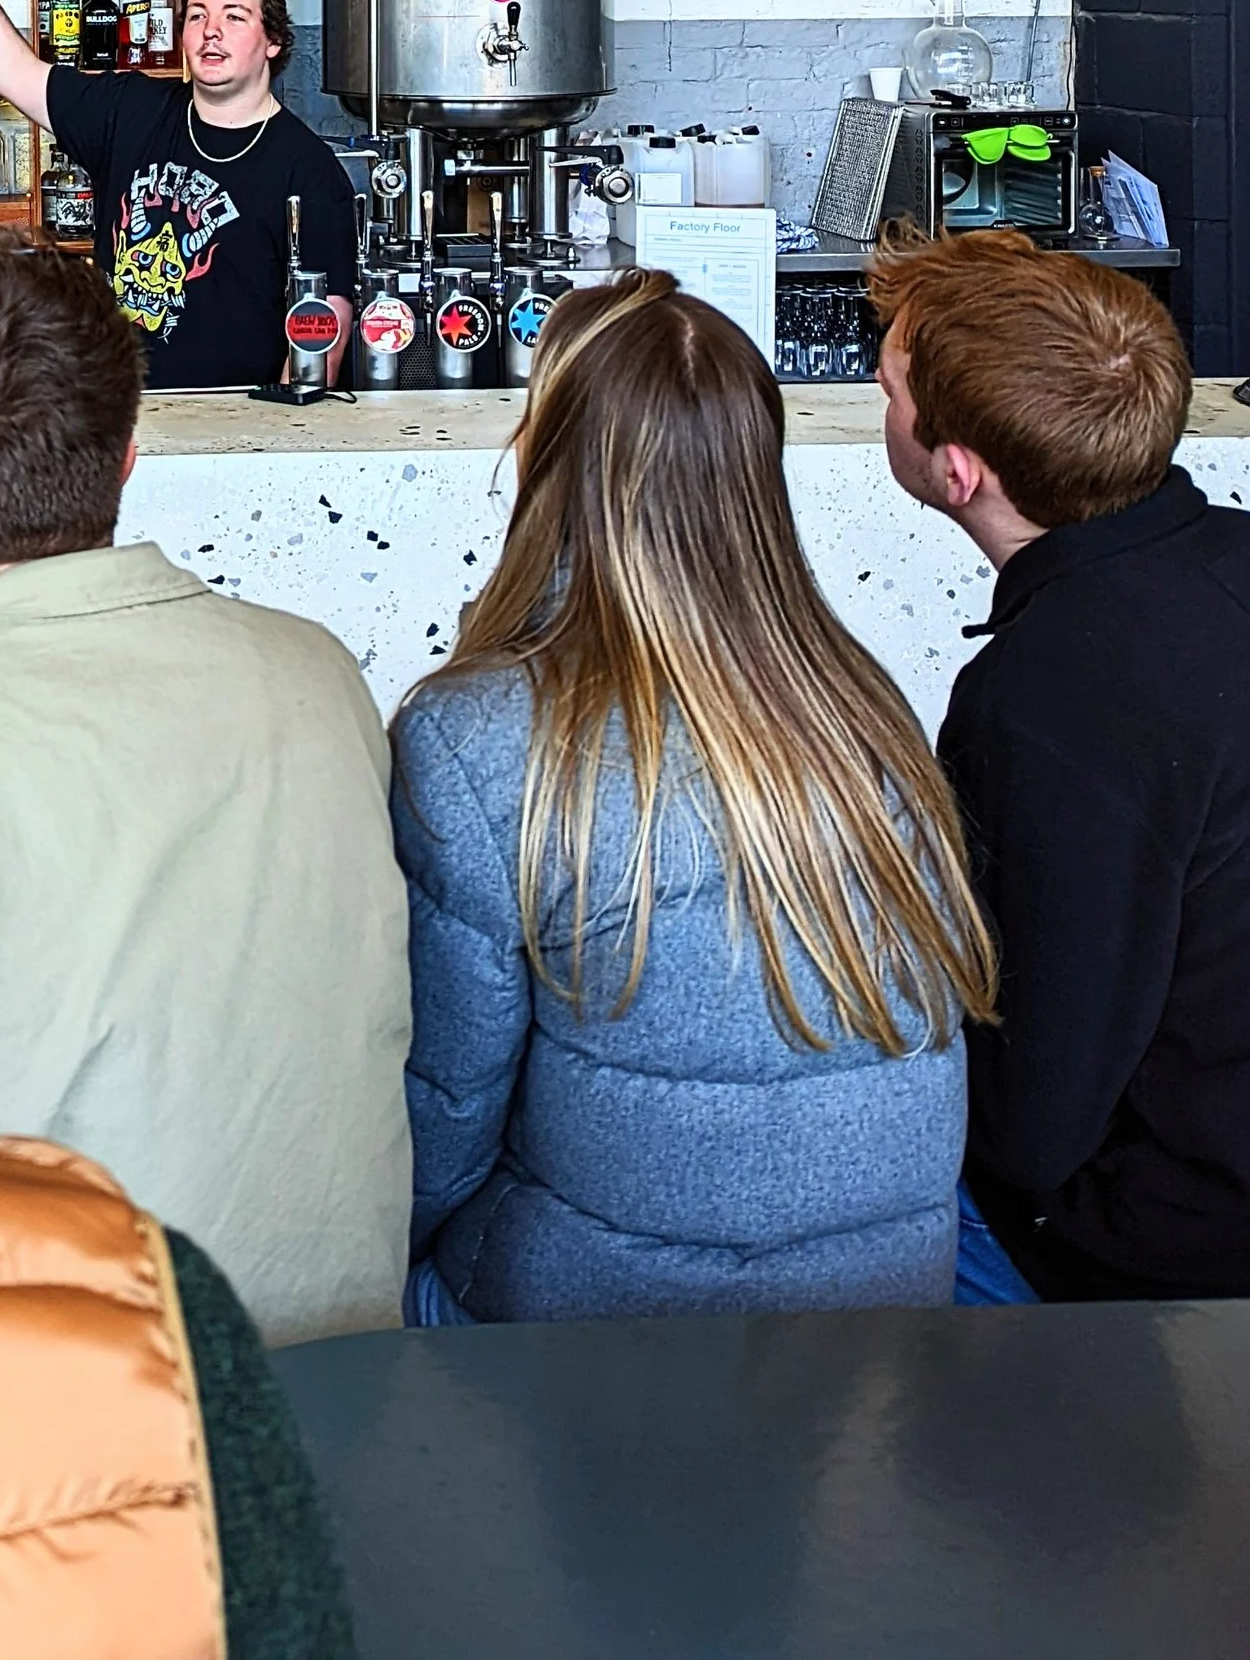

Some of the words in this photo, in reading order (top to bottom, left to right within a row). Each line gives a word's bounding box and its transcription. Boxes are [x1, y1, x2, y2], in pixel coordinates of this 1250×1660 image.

[670, 220, 710, 233] Factory
[713, 222, 741, 233] Floor
[458, 304, 485, 332] FREEDOM
[458, 334, 479, 346] PALE
